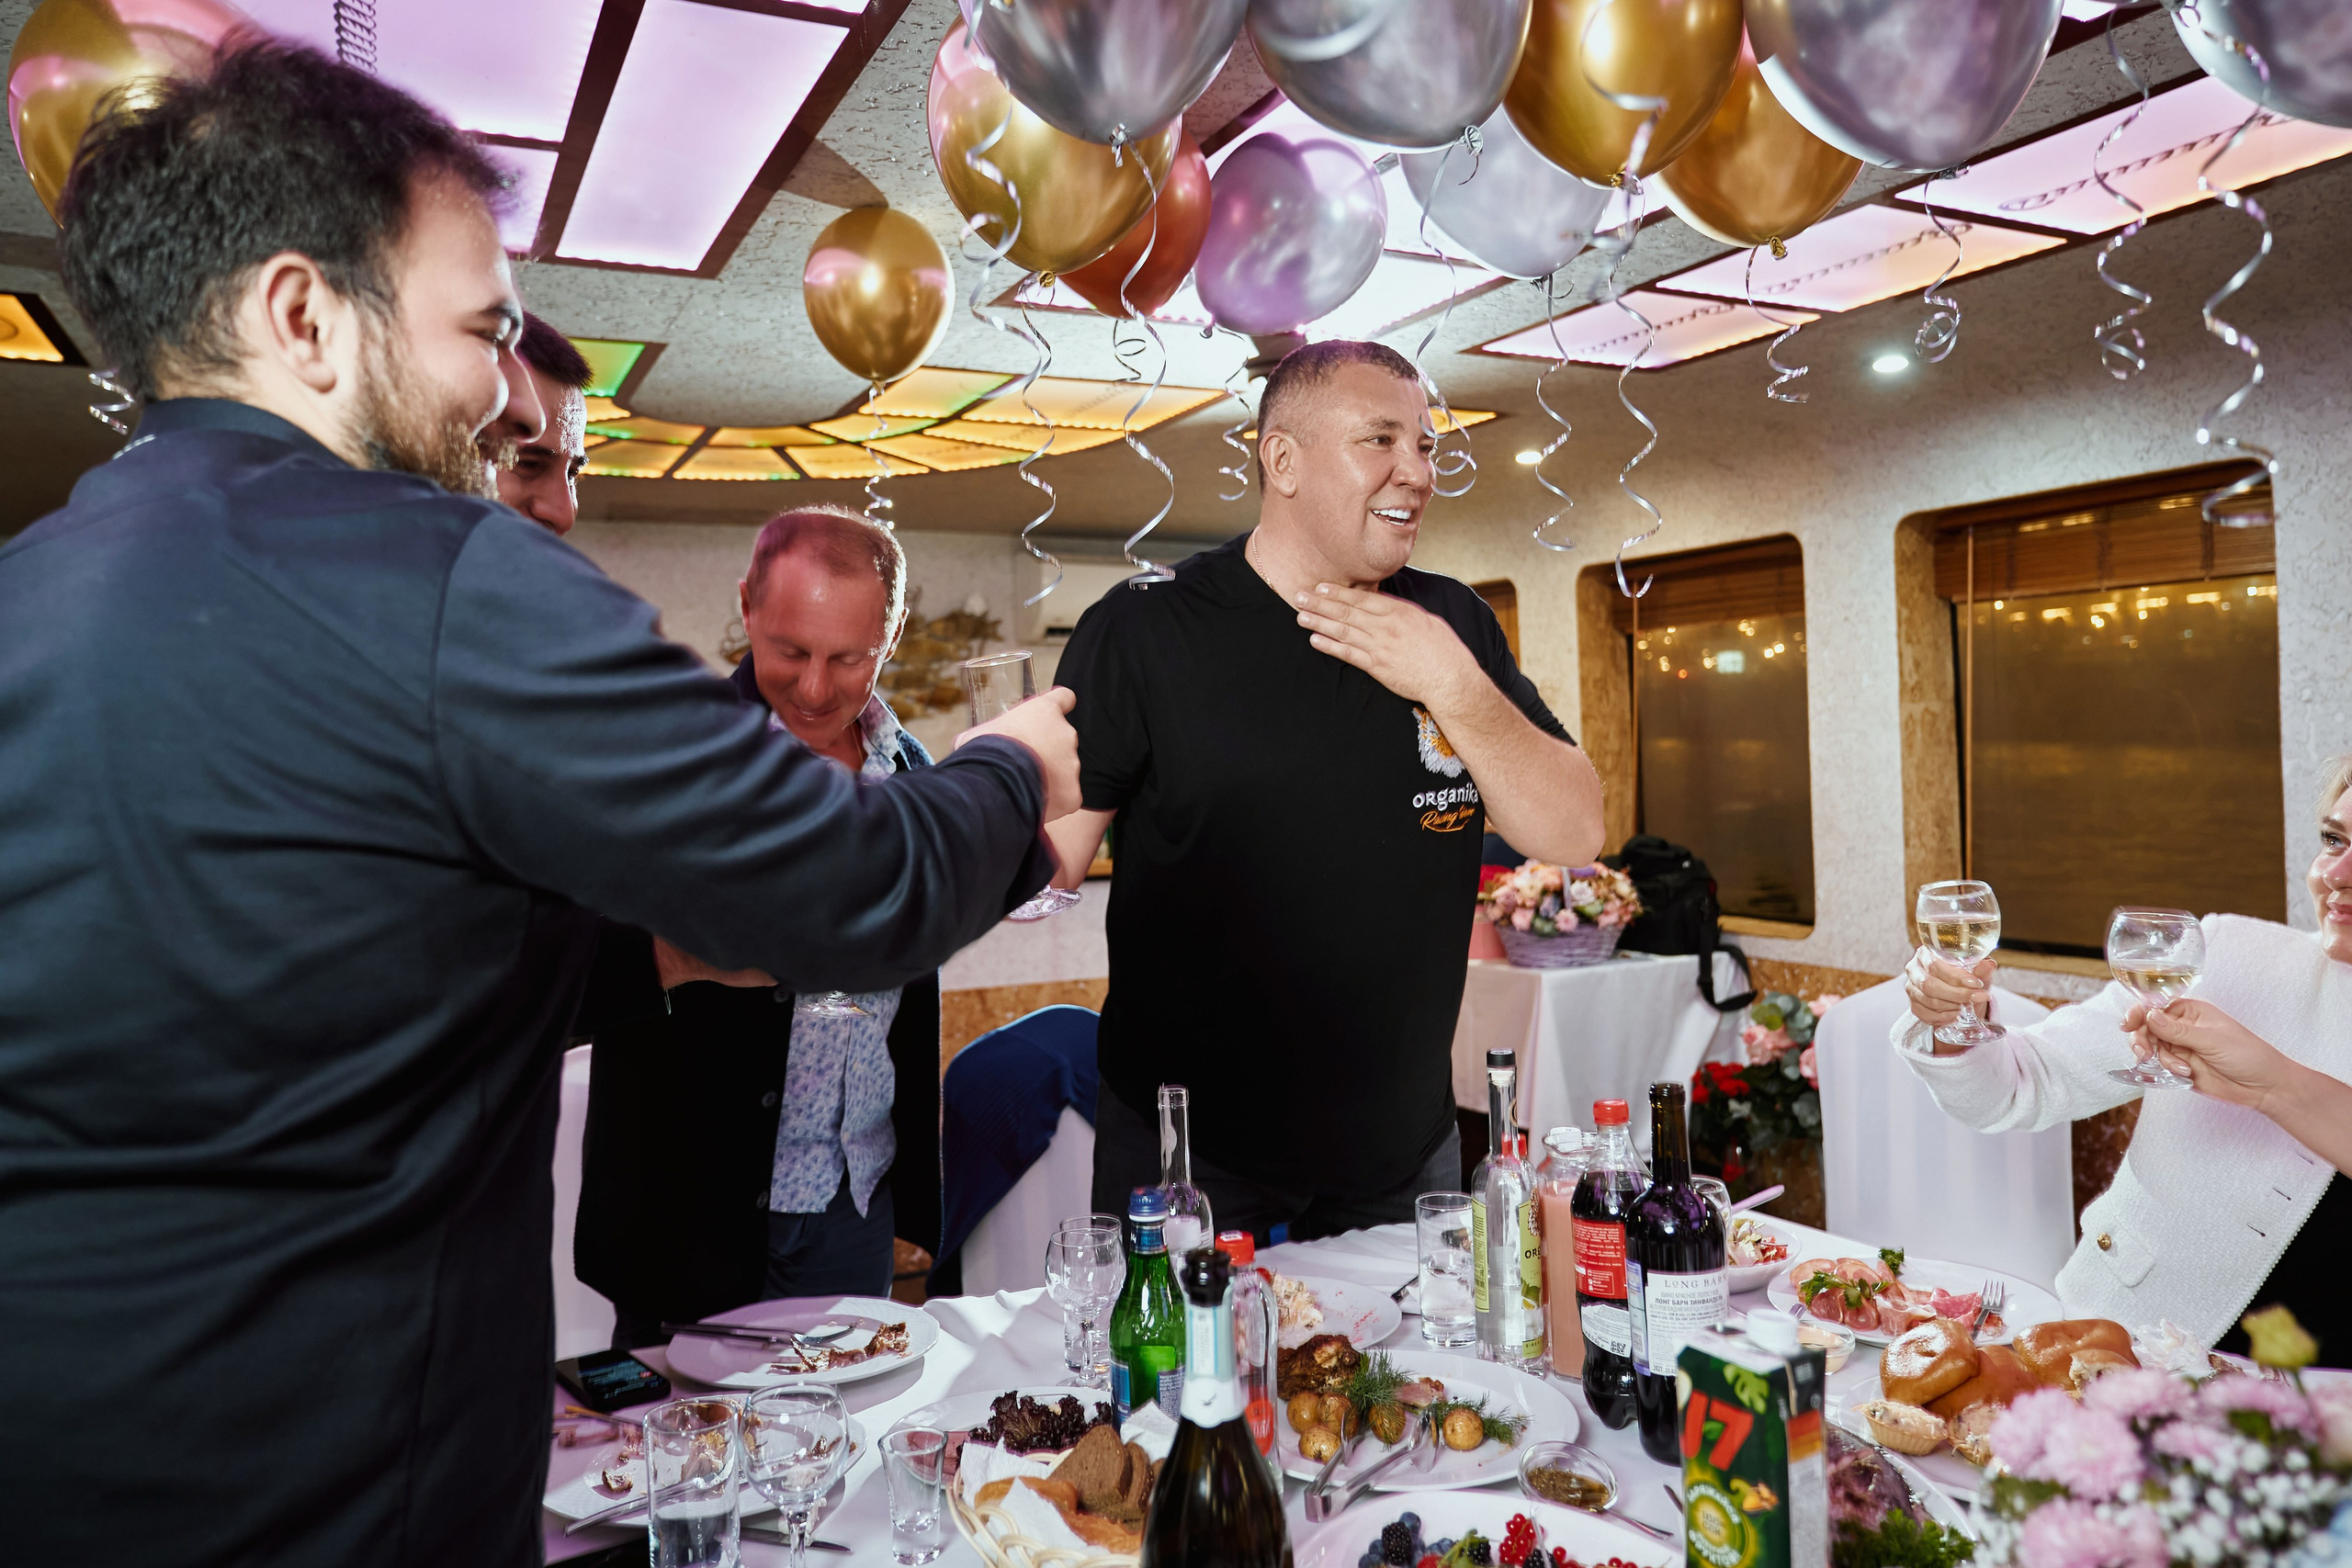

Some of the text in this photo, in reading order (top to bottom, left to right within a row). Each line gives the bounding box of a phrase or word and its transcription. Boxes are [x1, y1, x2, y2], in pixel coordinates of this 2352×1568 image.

[1664, 1280, 1698, 1288] LONG
[1690, 1295, 1723, 1305] ЗИНФАНДЕЛЬ
[1680, 1389, 1754, 1472] J7
